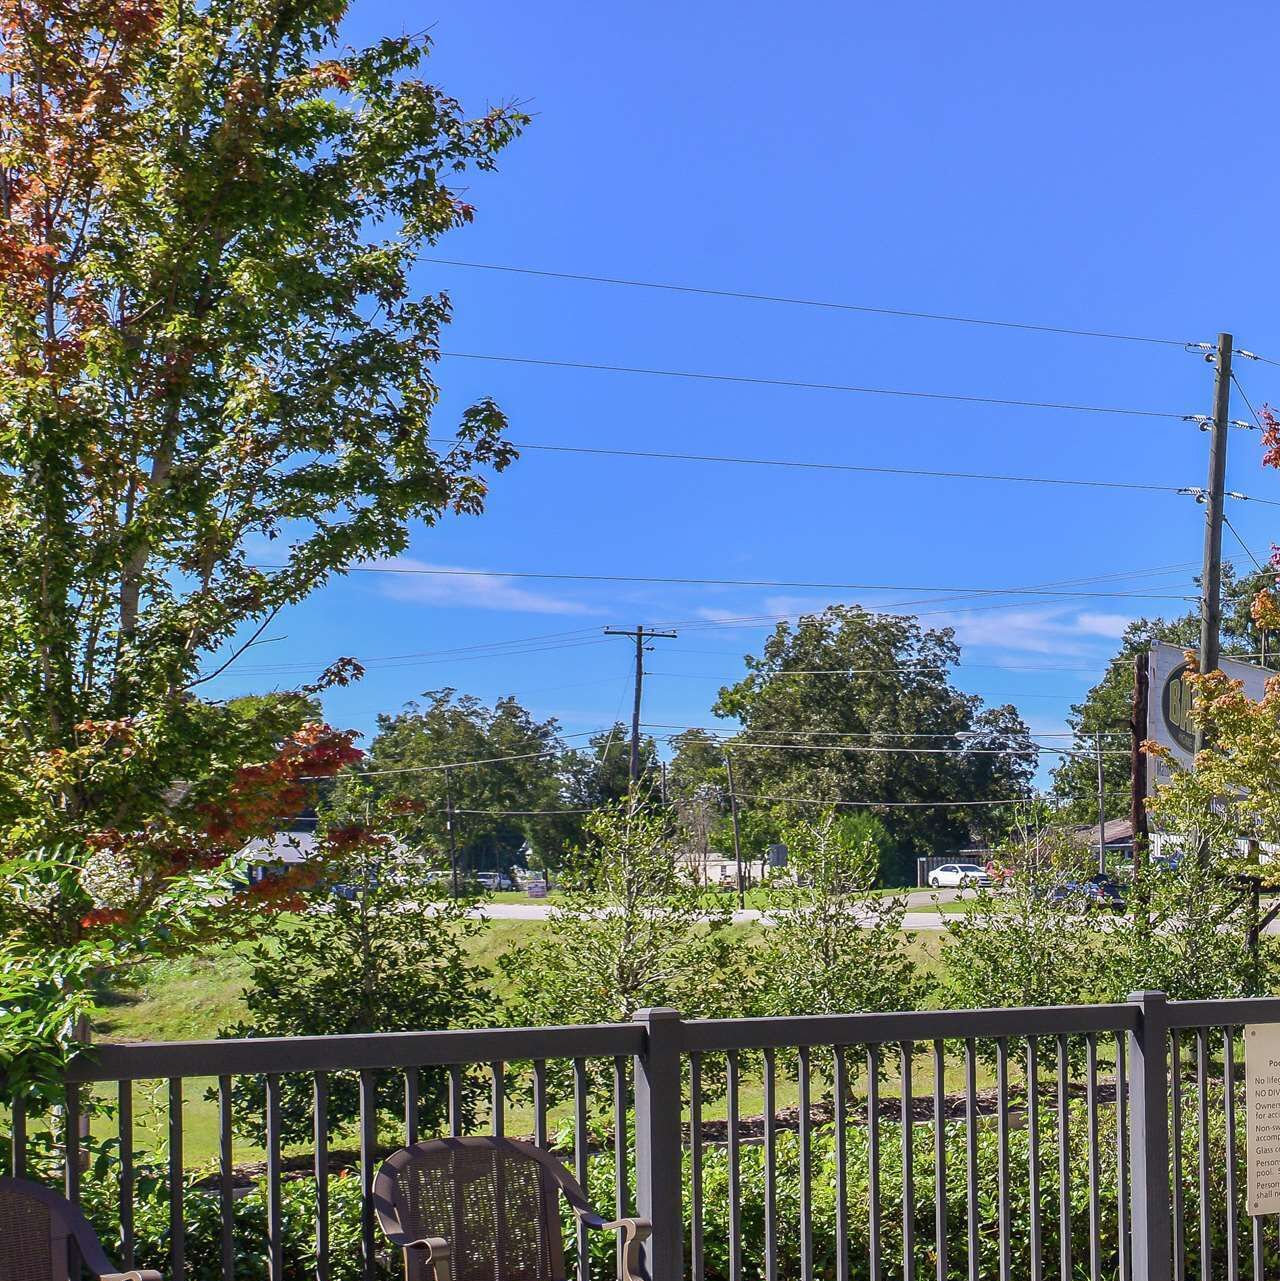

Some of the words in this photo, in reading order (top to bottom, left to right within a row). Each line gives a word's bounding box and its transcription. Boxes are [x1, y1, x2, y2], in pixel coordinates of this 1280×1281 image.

[1255, 1089, 1266, 1097] NO
[1255, 1102, 1280, 1110] Owners
[1255, 1111, 1265, 1119] for
[1255, 1146, 1273, 1154] Glass
[1256, 1190, 1272, 1199] shall
